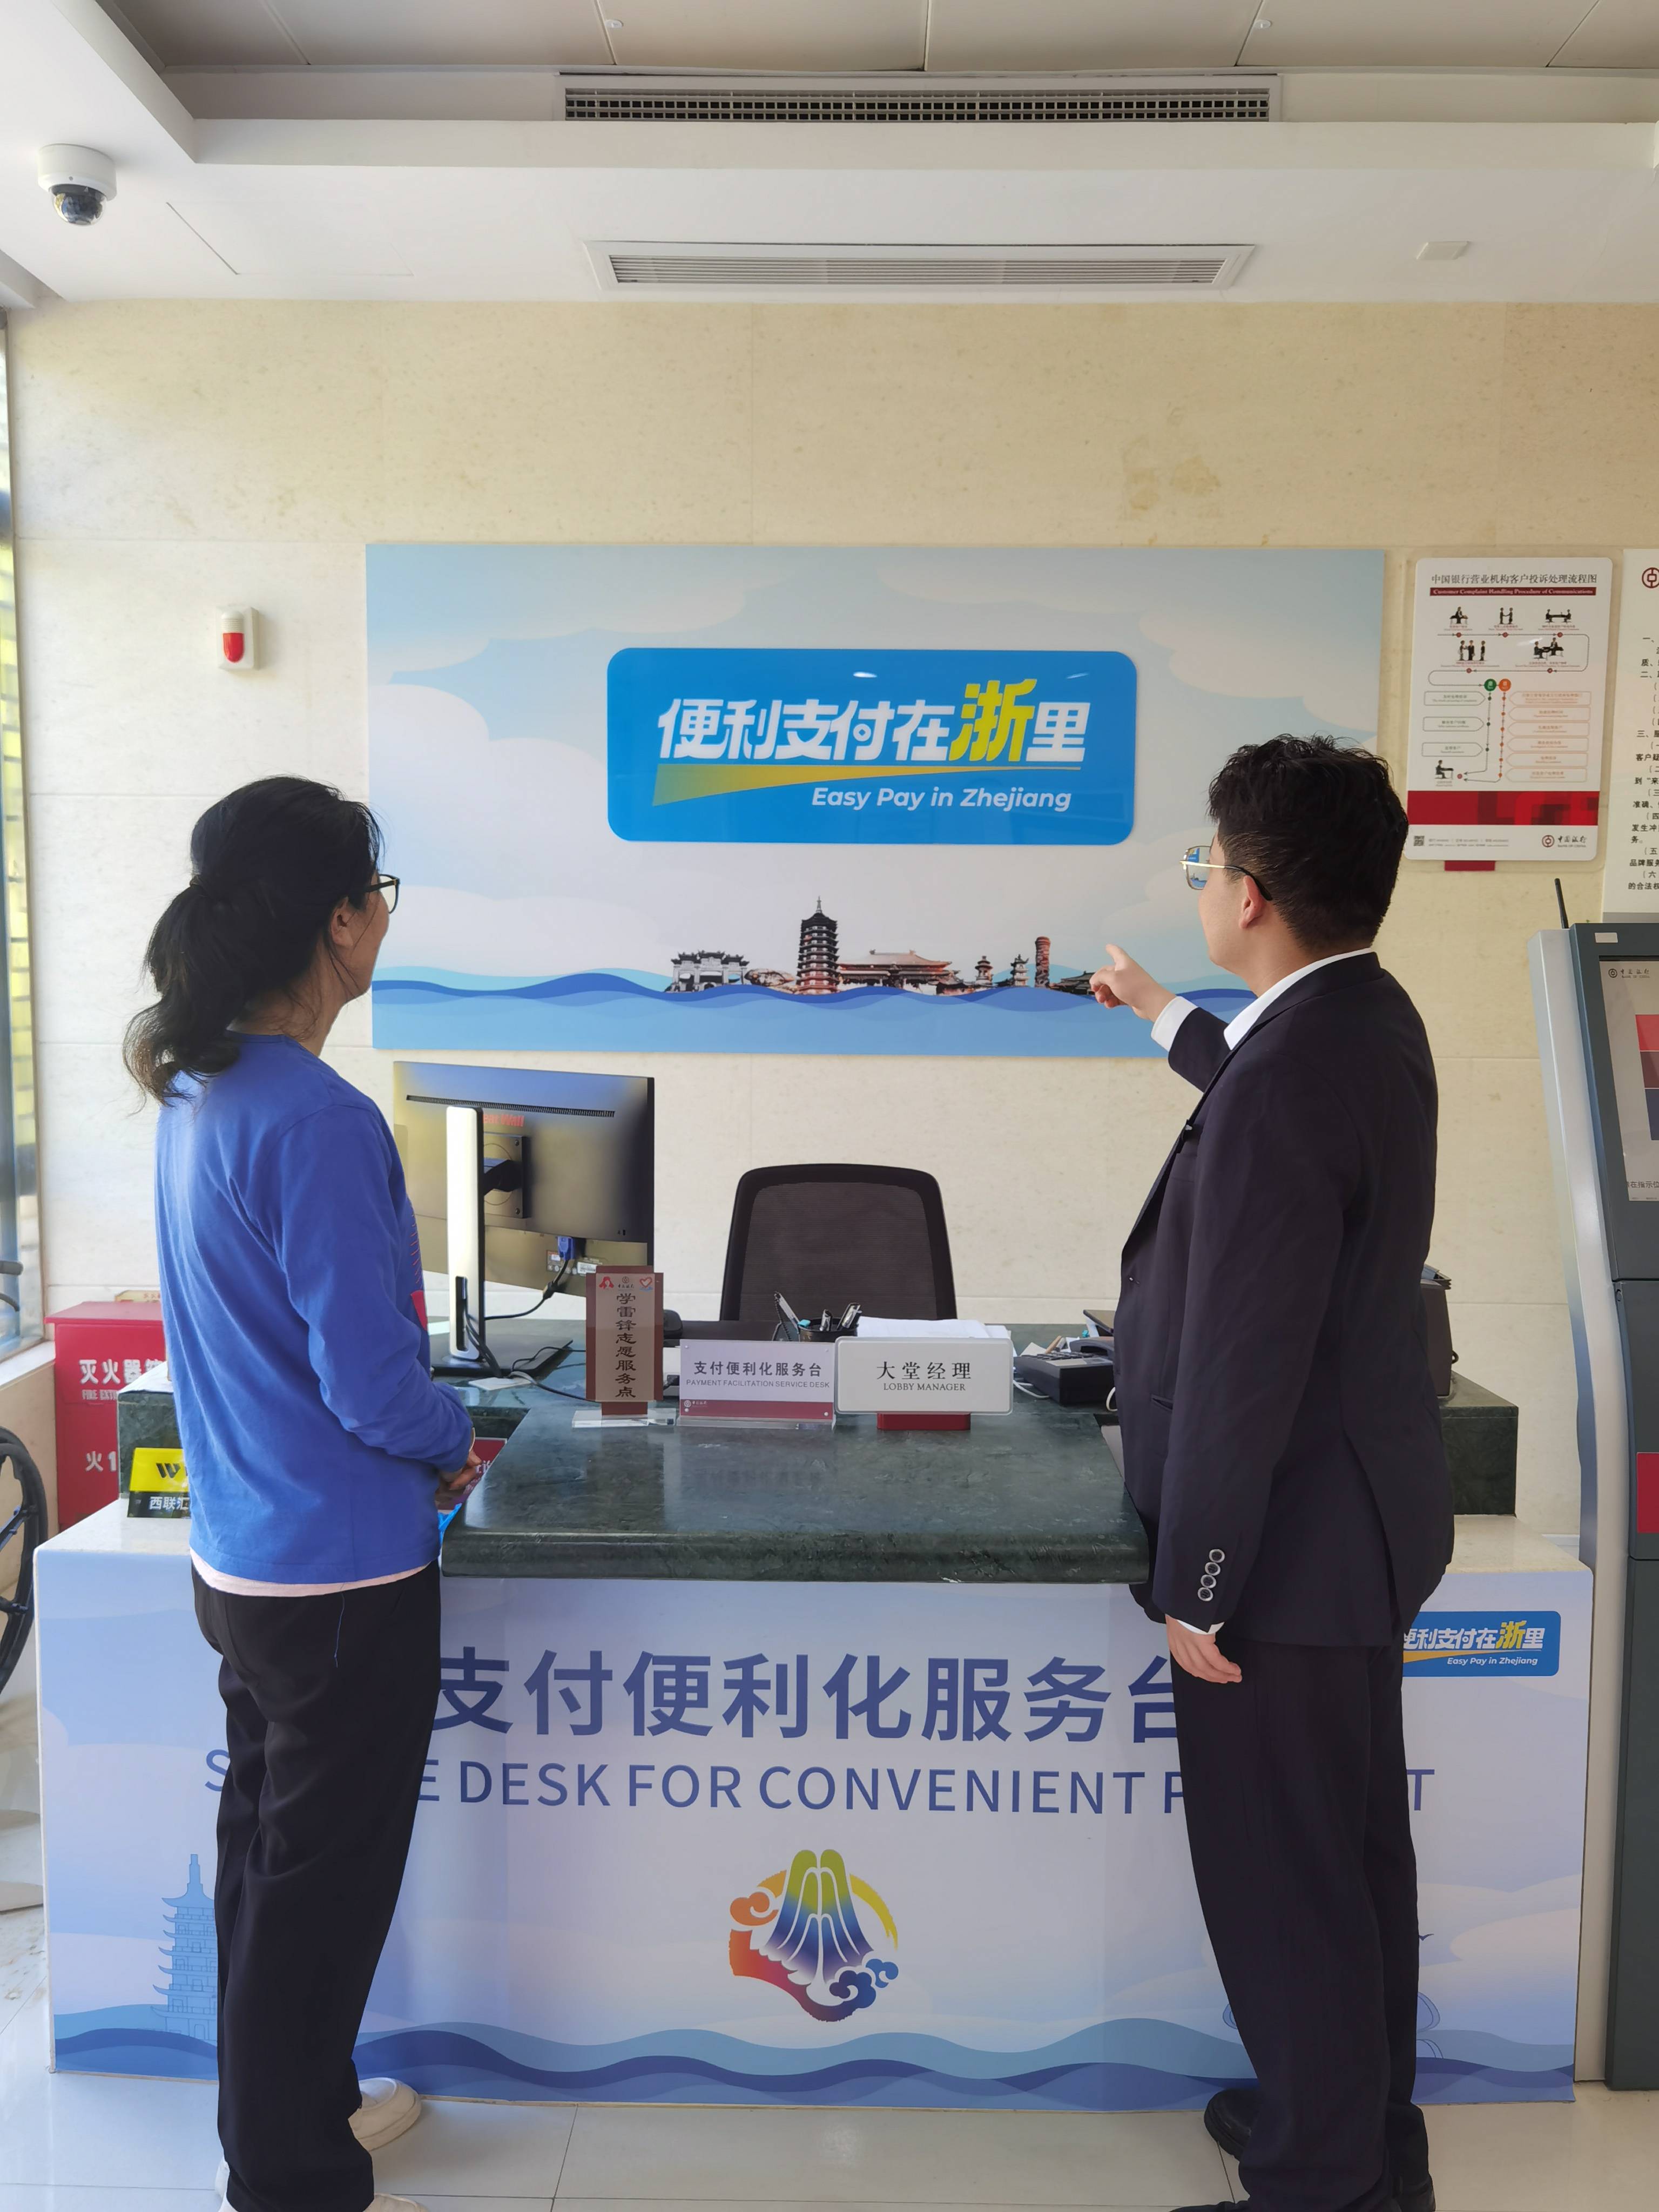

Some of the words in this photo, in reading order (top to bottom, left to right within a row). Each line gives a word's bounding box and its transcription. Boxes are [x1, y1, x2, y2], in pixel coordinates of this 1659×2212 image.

[1432, 574, 1597, 584] 中国银行营业机构客户投诉处理流程图
[658, 678, 1091, 762] 便利支付在浙里
[812, 787, 871, 811] Easy
[876, 787, 925, 811] Pay
[930, 787, 954, 807] in
[960, 787, 1072, 812] Zhejiang
[615, 1293, 637, 1398] 学雷锋志愿服务点
[694, 1361, 821, 1377] 支付便利化服务台
[876, 1361, 972, 1379] 大堂经理
[917, 1383, 966, 1391] MANAGER
[149, 1496, 190, 1510] 西联汇
[1447, 1657, 1468, 1666] Easy
[1470, 1657, 1487, 1666] Pay
[1499, 1657, 1538, 1666] Zhejiang
[431, 1646, 1177, 1743] 支付便利化服务台
[461, 1761, 611, 1806] DESK
[628, 1764, 742, 1808] FOR
[759, 1765, 1145, 1815] CONVENIENT
